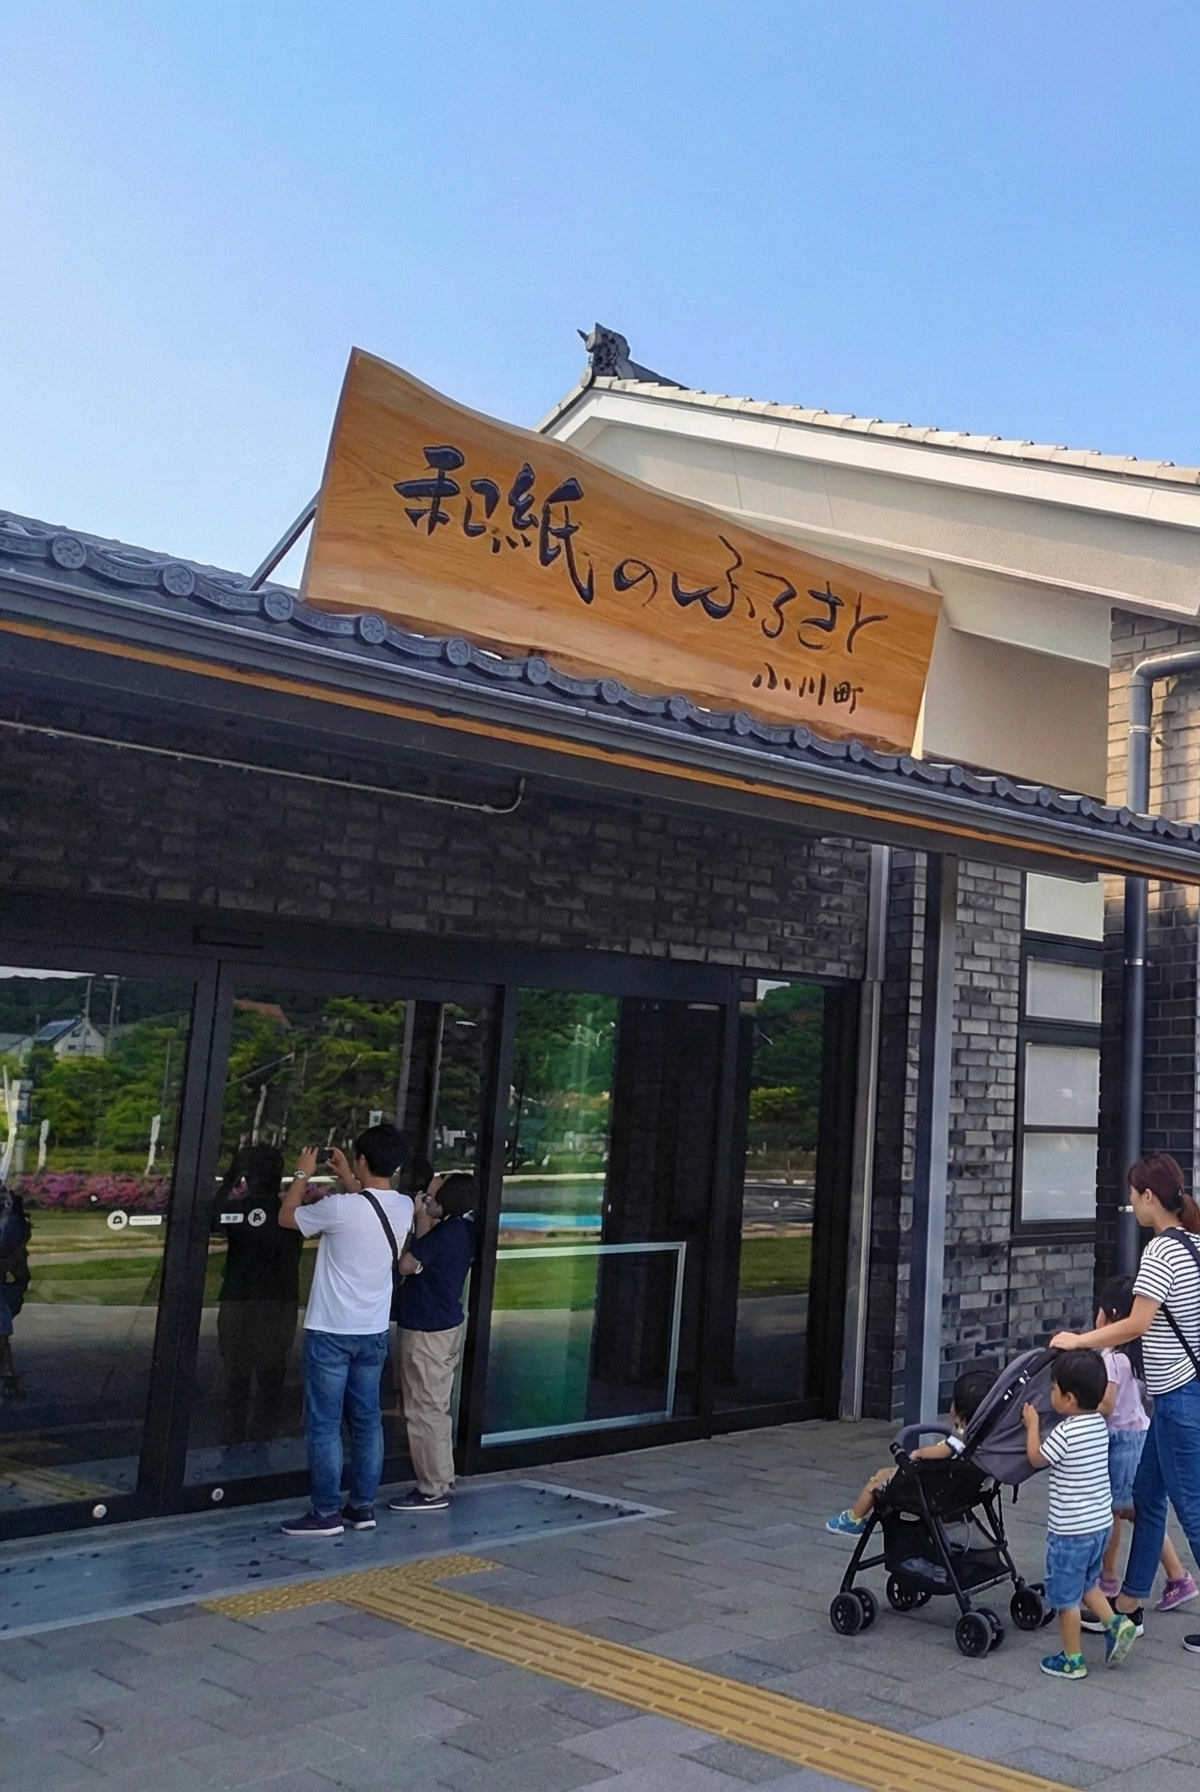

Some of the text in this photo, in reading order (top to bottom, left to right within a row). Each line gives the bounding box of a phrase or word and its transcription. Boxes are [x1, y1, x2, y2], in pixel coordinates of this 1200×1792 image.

[393, 445, 889, 654] 和紙のふるさと
[752, 662, 864, 714] 小川町
